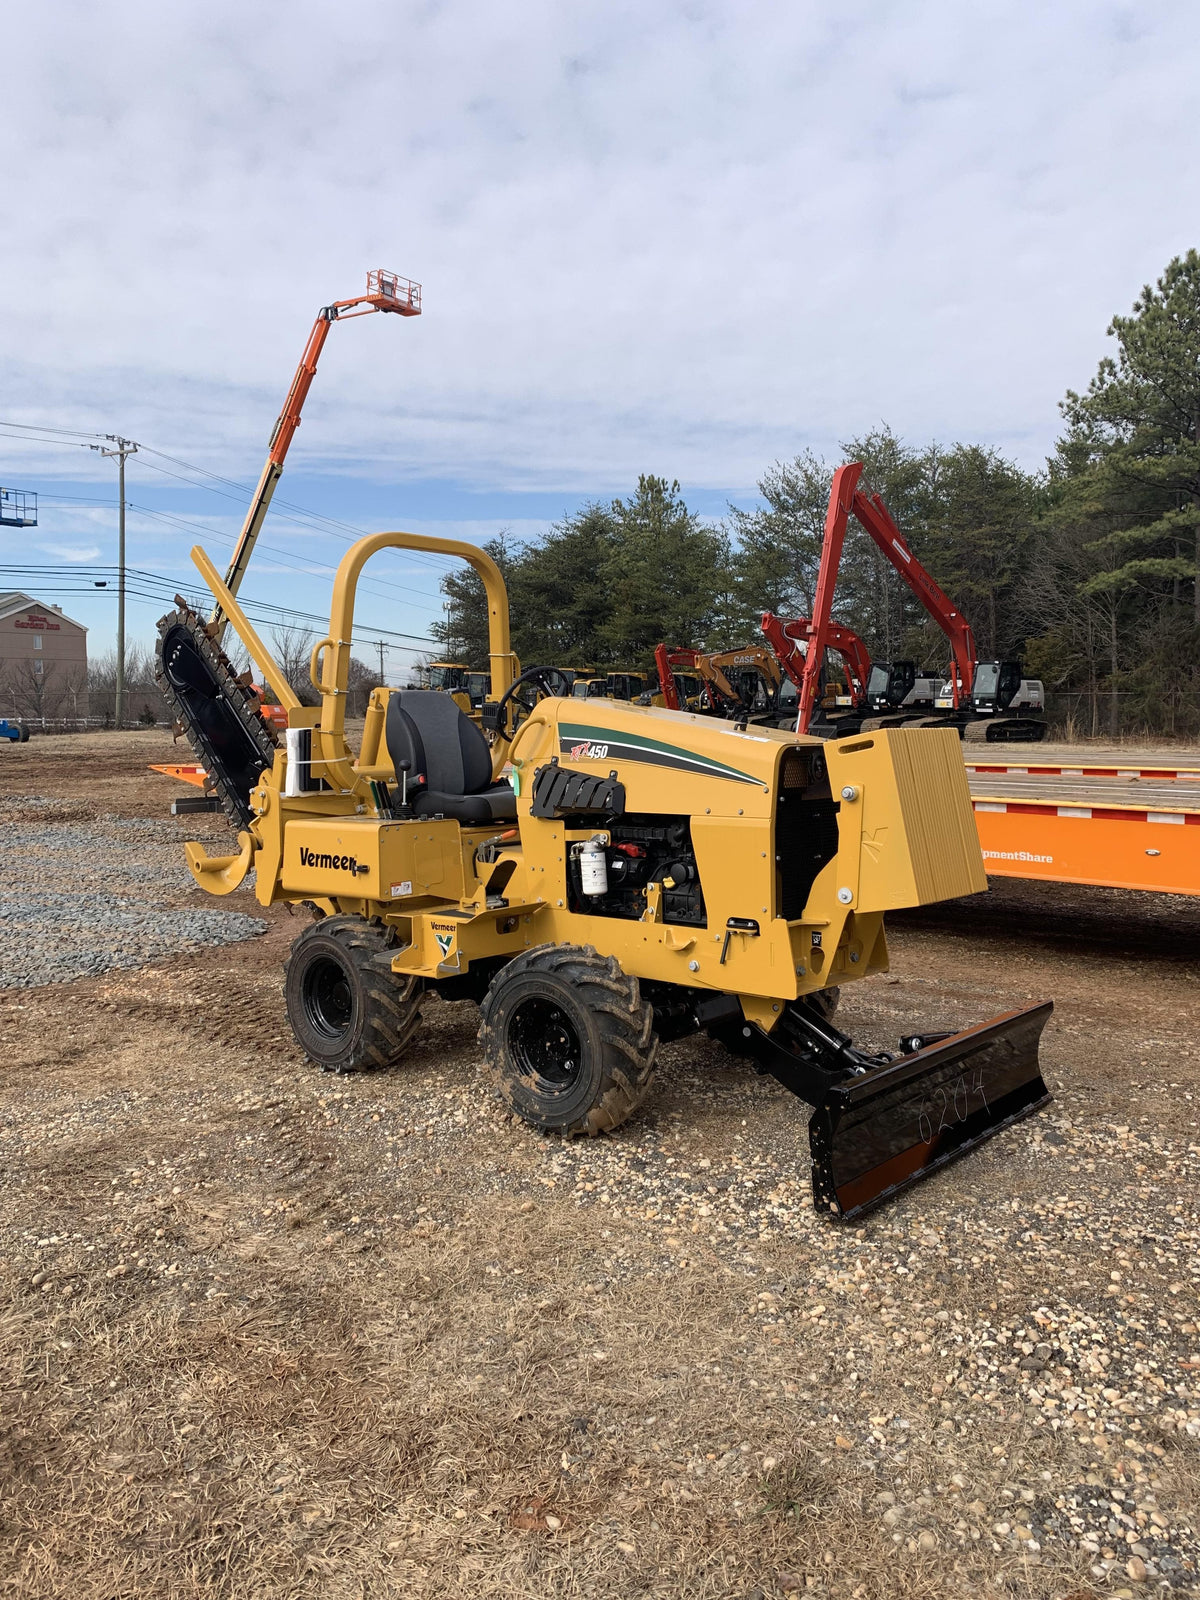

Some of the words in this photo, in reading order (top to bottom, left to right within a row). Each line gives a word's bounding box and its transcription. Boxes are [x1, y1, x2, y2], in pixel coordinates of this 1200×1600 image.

[15, 620, 44, 630] Garden
[46, 621, 60, 630] Inn
[733, 655, 756, 664] CASE
[300, 847, 357, 871] Vermeer
[431, 921, 456, 932] Vermeer
